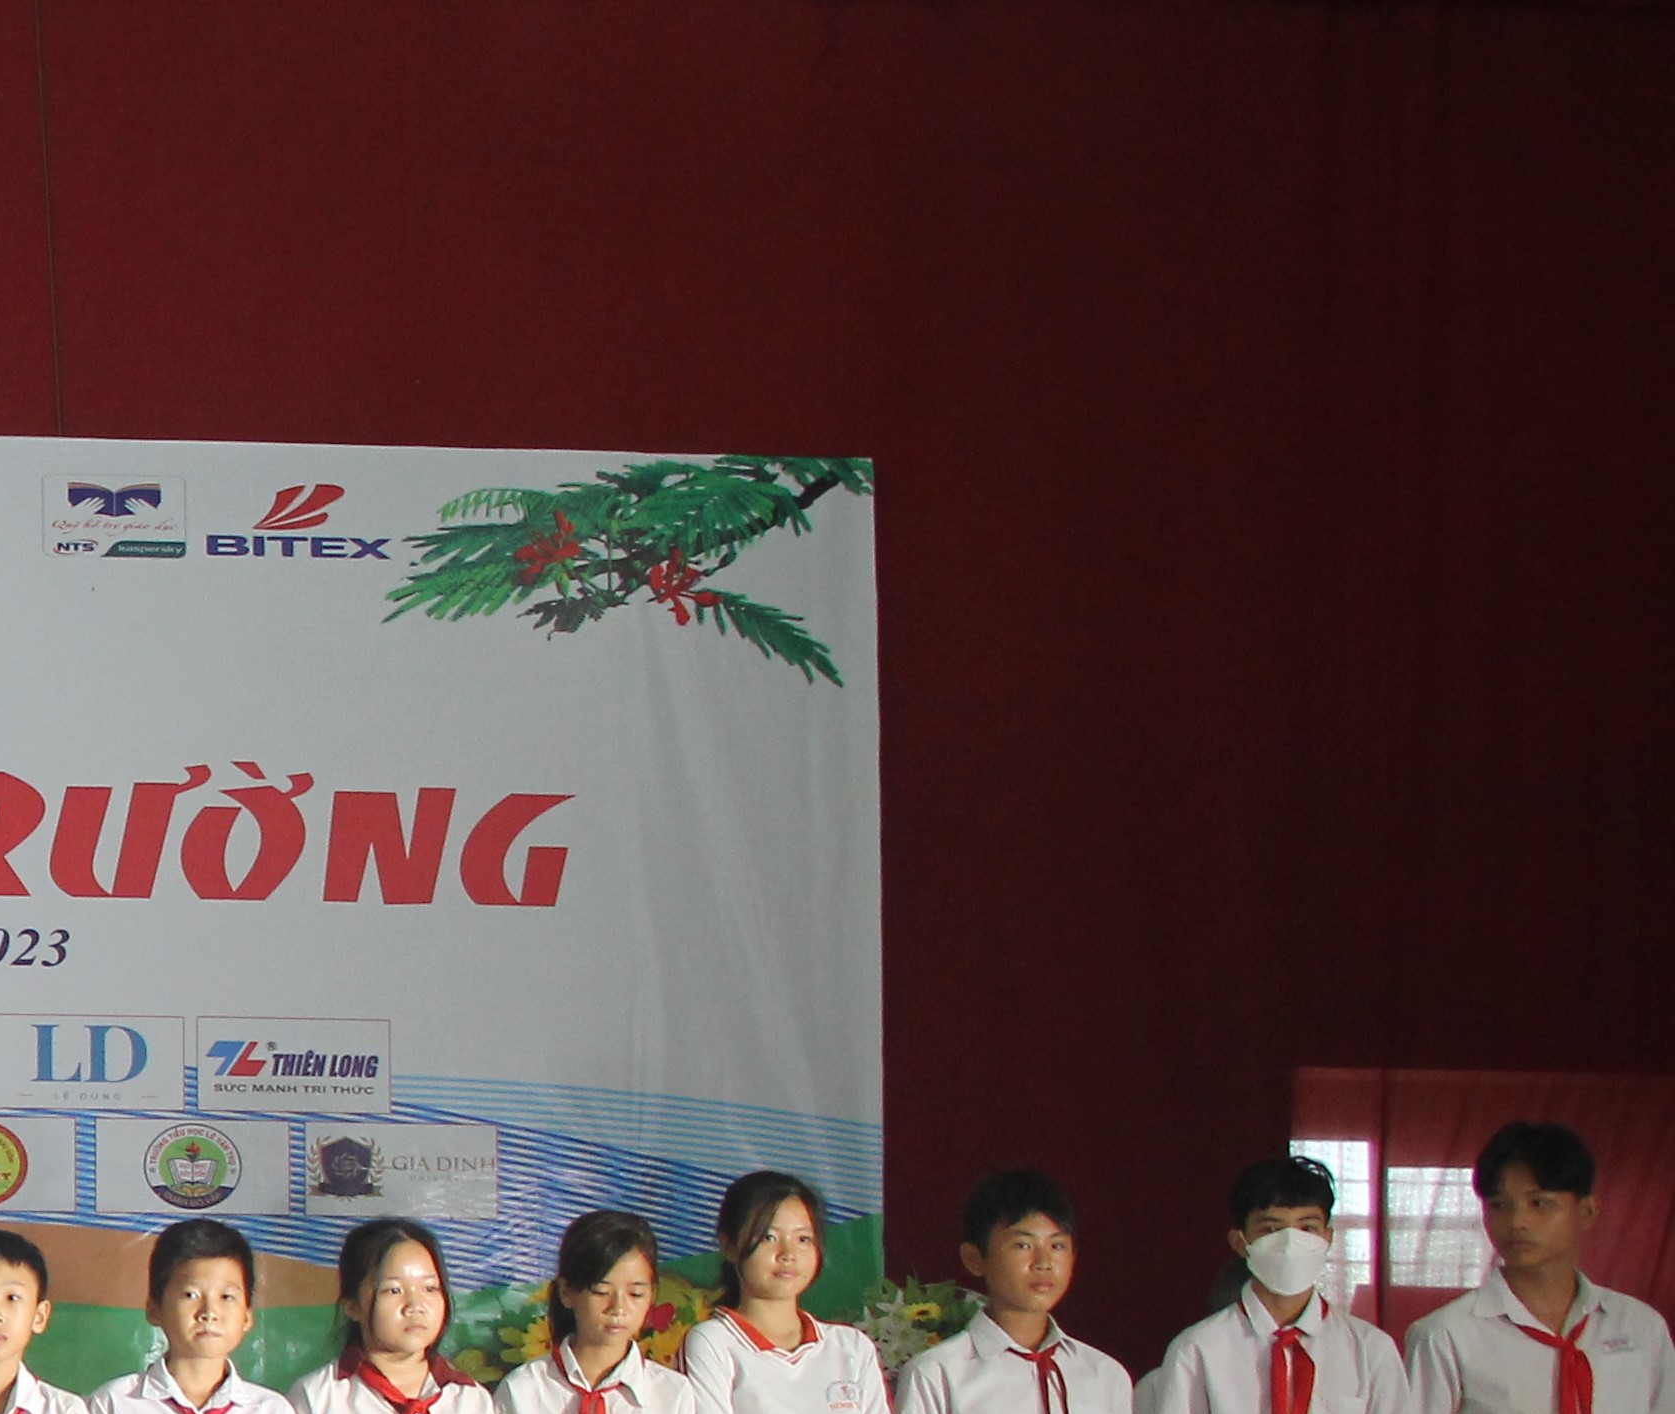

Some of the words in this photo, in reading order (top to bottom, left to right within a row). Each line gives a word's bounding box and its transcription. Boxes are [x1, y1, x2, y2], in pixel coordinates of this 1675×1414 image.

[57, 542, 95, 552] NTS
[206, 534, 391, 560] BITEX
[31, 1024, 148, 1082] LD
[272, 1050, 327, 1077] THIÊN
[329, 1054, 379, 1078] LONG
